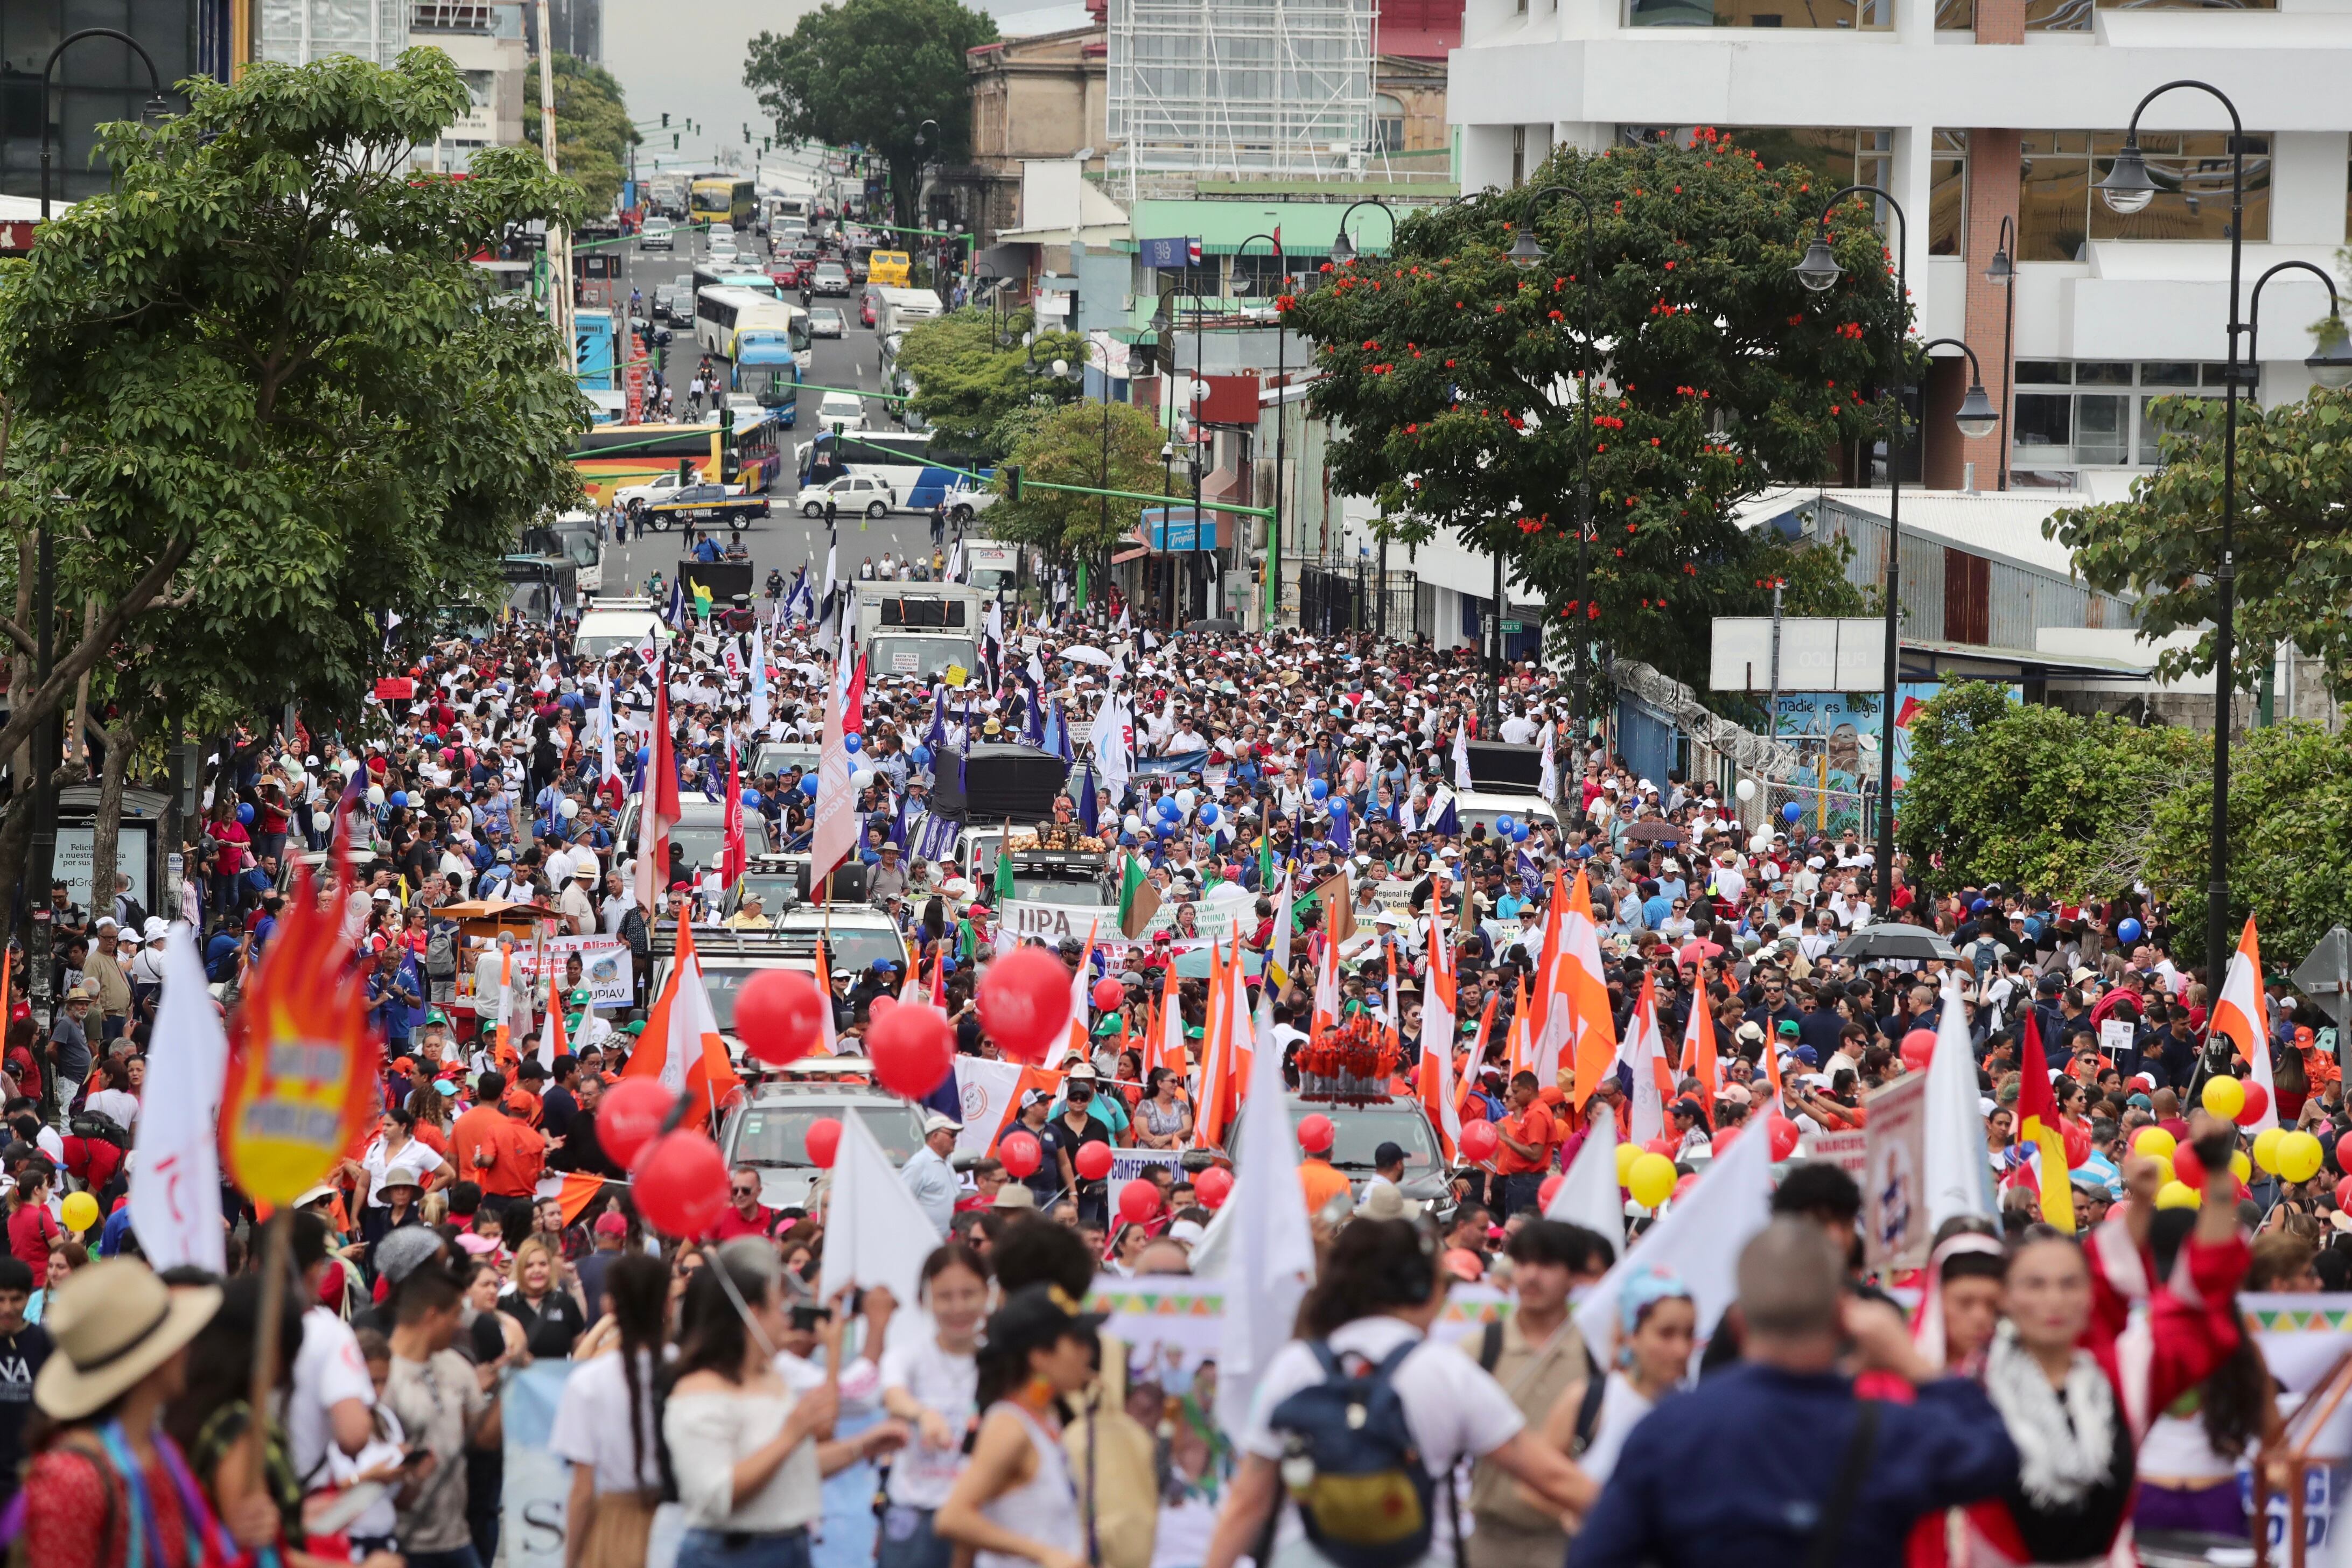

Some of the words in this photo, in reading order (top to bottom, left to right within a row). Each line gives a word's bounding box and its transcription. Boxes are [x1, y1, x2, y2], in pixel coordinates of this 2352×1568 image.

[1167, 531, 1201, 547] Tropica
[1779, 698, 1816, 712] nadie
[1825, 701, 1840, 712] es
[1375, 890, 1400, 898] Regional
[1018, 908, 1071, 936] UPA
[1202, 913, 1226, 923] RUINA
[582, 941, 621, 950] Alianz
[1113, 960, 1119, 968] la
